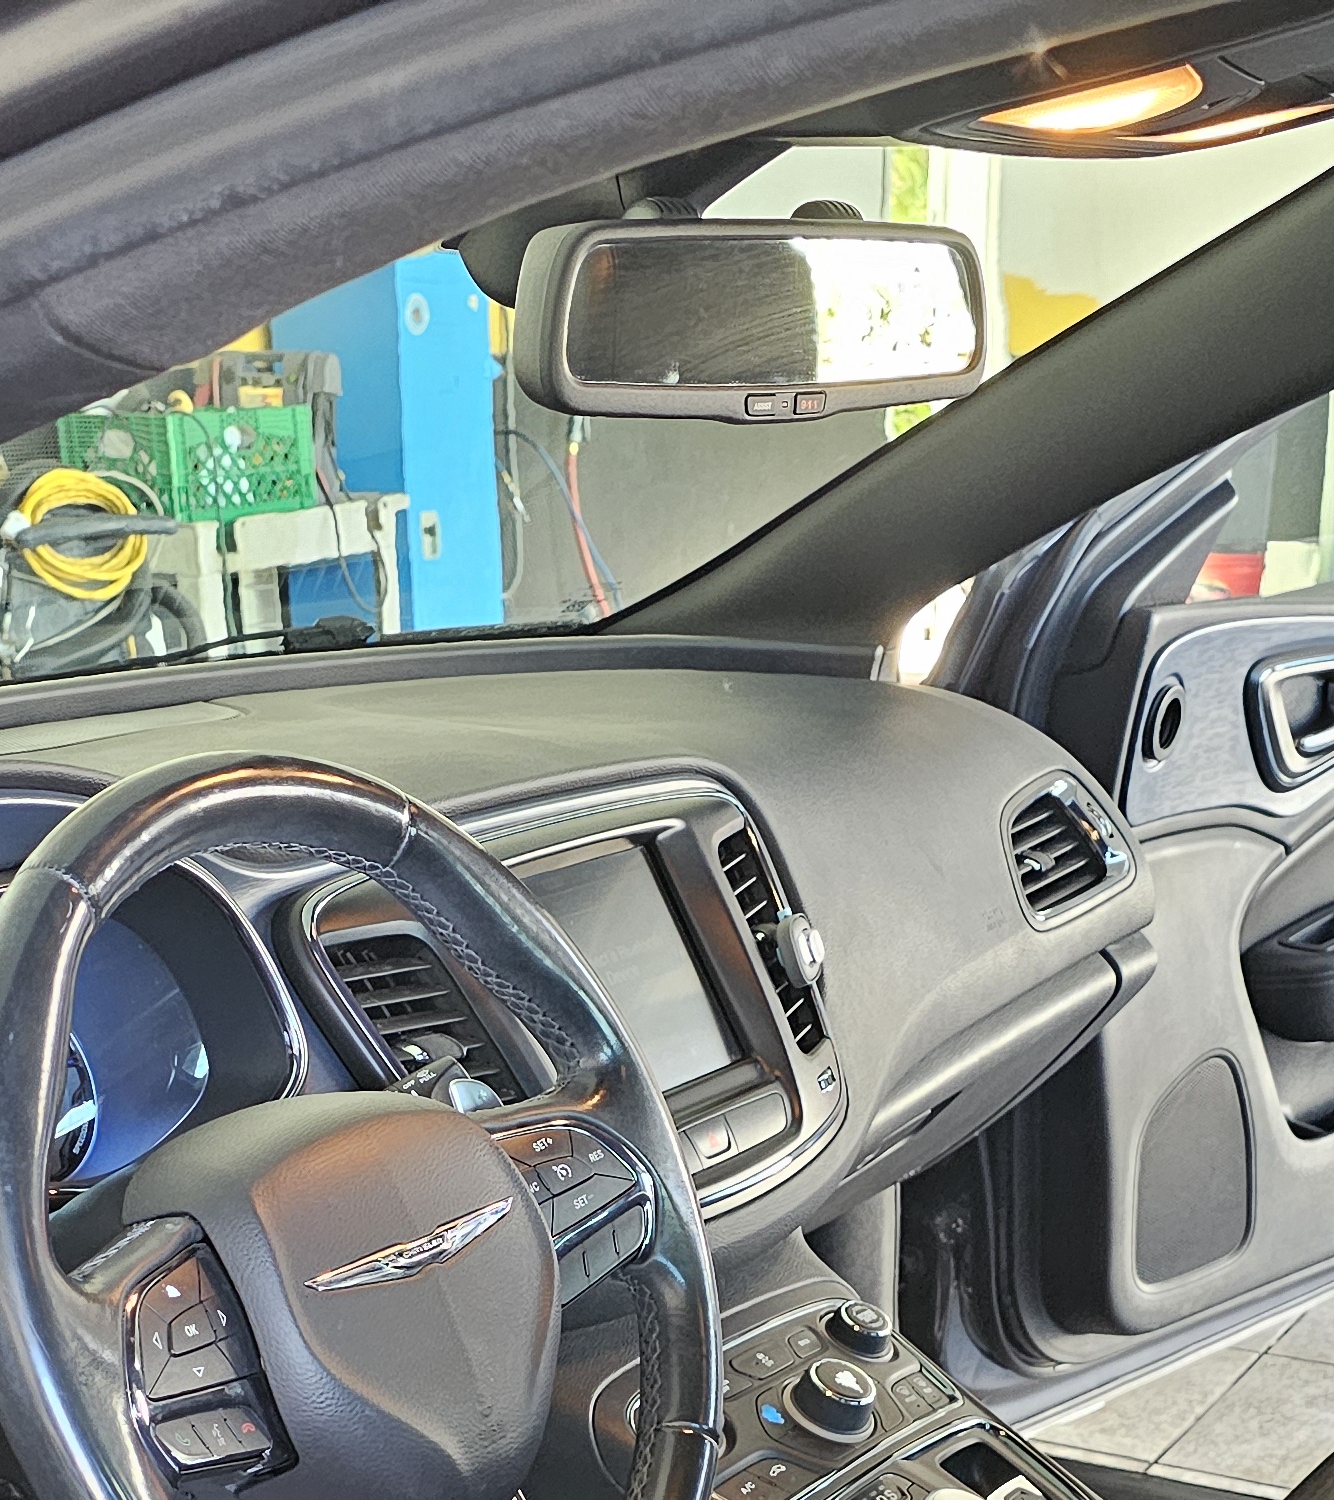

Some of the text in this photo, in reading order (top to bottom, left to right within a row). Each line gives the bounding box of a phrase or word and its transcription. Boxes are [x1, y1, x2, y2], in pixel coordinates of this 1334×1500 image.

[588, 1149, 605, 1163] RES
[184, 1323, 200, 1338] OK
[740, 1480, 756, 1496] A/C
